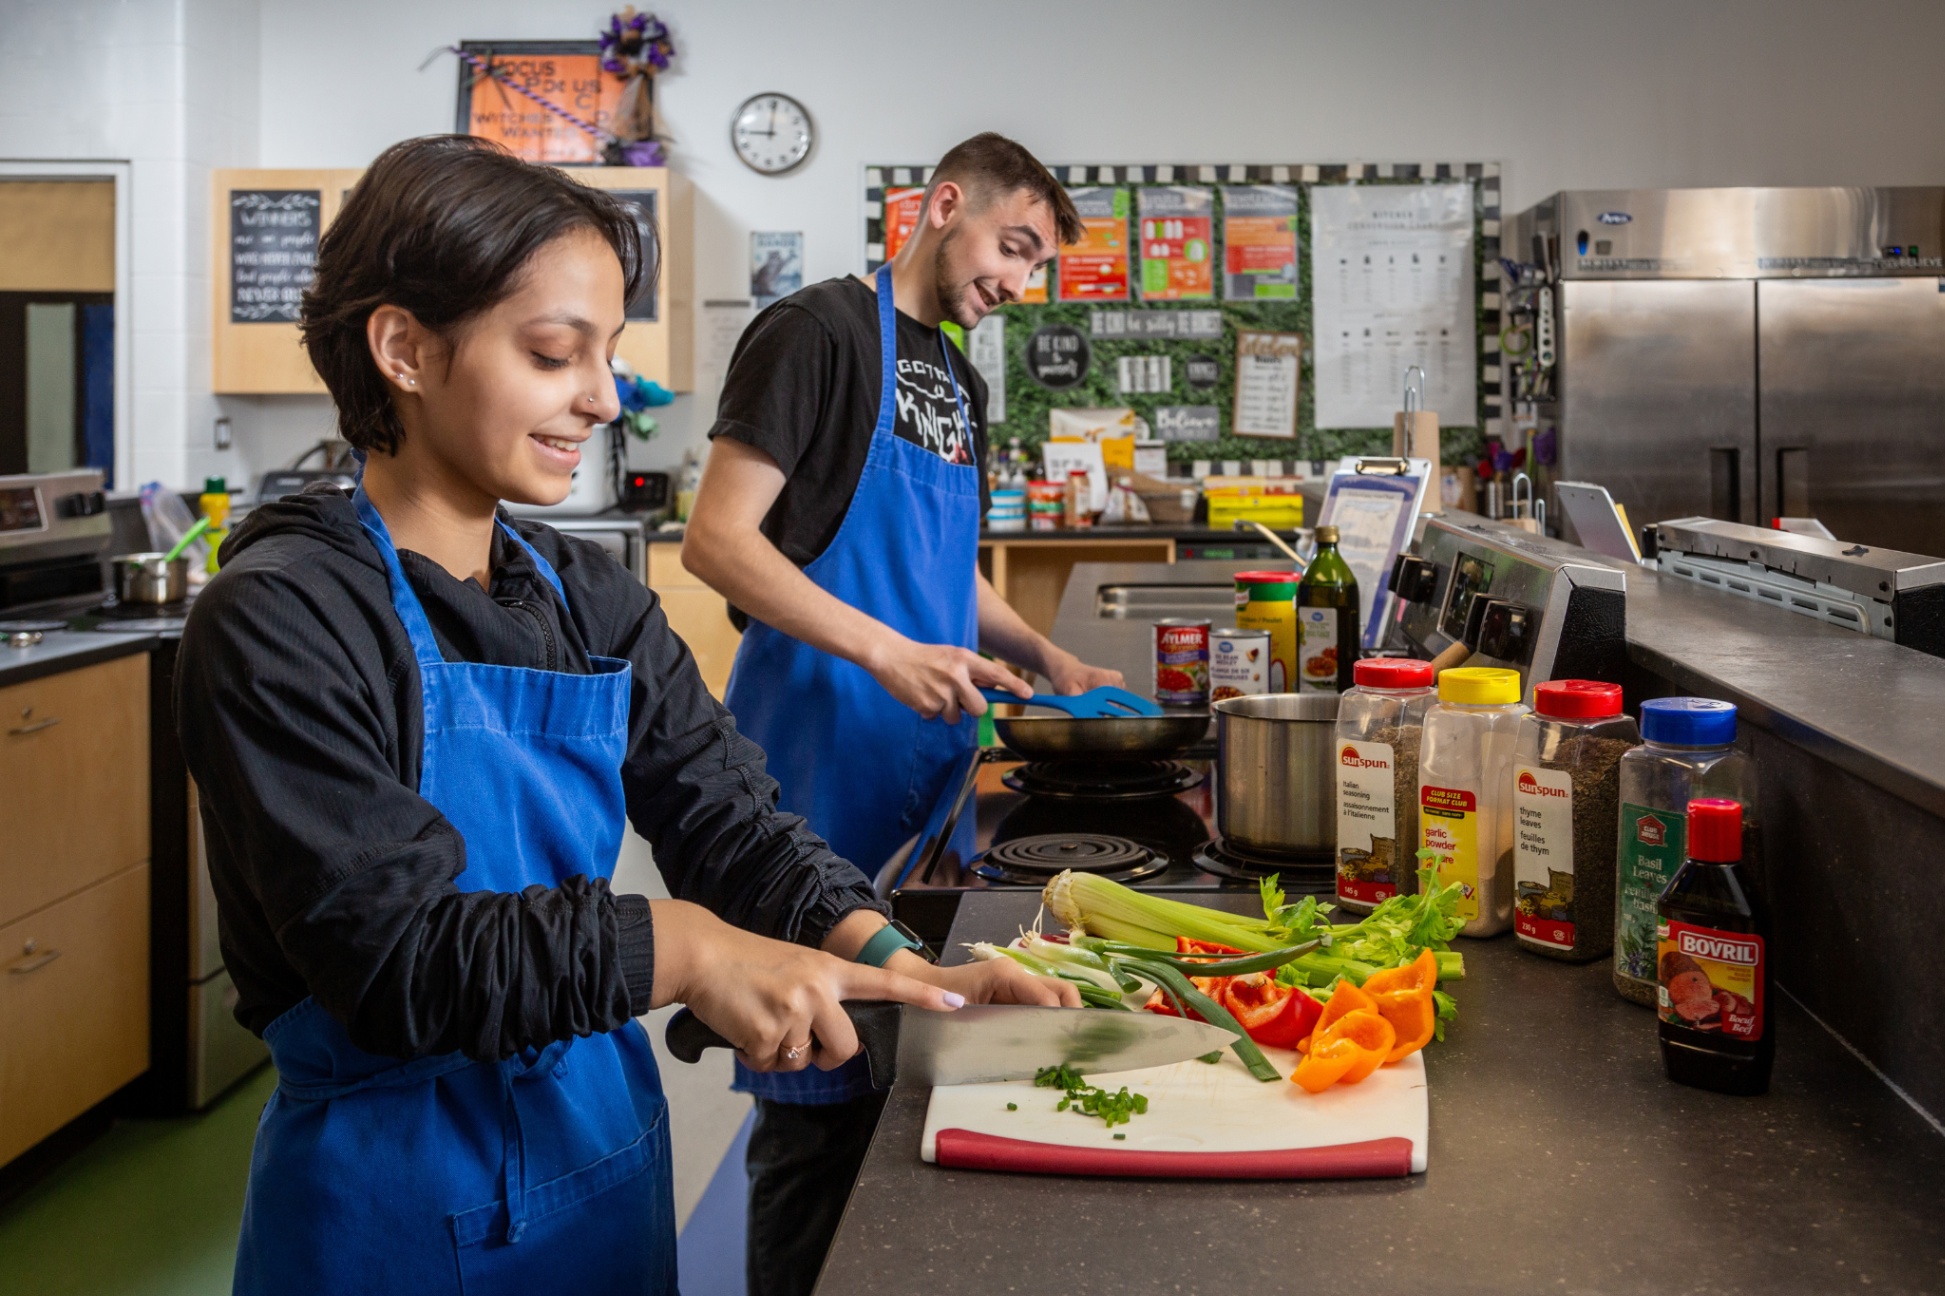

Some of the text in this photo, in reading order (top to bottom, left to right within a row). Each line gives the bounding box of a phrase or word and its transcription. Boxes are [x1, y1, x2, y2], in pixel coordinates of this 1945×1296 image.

[1160, 632, 1203, 645] AYLMER
[1342, 755, 1387, 769] sunspun
[1343, 780, 1360, 789] Italian
[1520, 782, 1566, 798] sunspun
[1343, 789, 1371, 801] seasoning
[1426, 795, 1468, 807] FORMAT CLUB
[1431, 790, 1462, 800] CLUB SIZE
[1520, 806, 1542, 819] thyme
[1520, 816, 1542, 829] leaves
[1425, 828, 1448, 839] garlic
[1520, 830, 1546, 845] feuilles
[1425, 839, 1457, 851] powder
[1520, 841, 1550, 856] de thym
[1638, 854, 1663, 871] Basil
[1633, 865, 1668, 884] Leaves
[1682, 935, 1754, 962] BOVRIL
[1731, 1023, 1755, 1036] Beef
